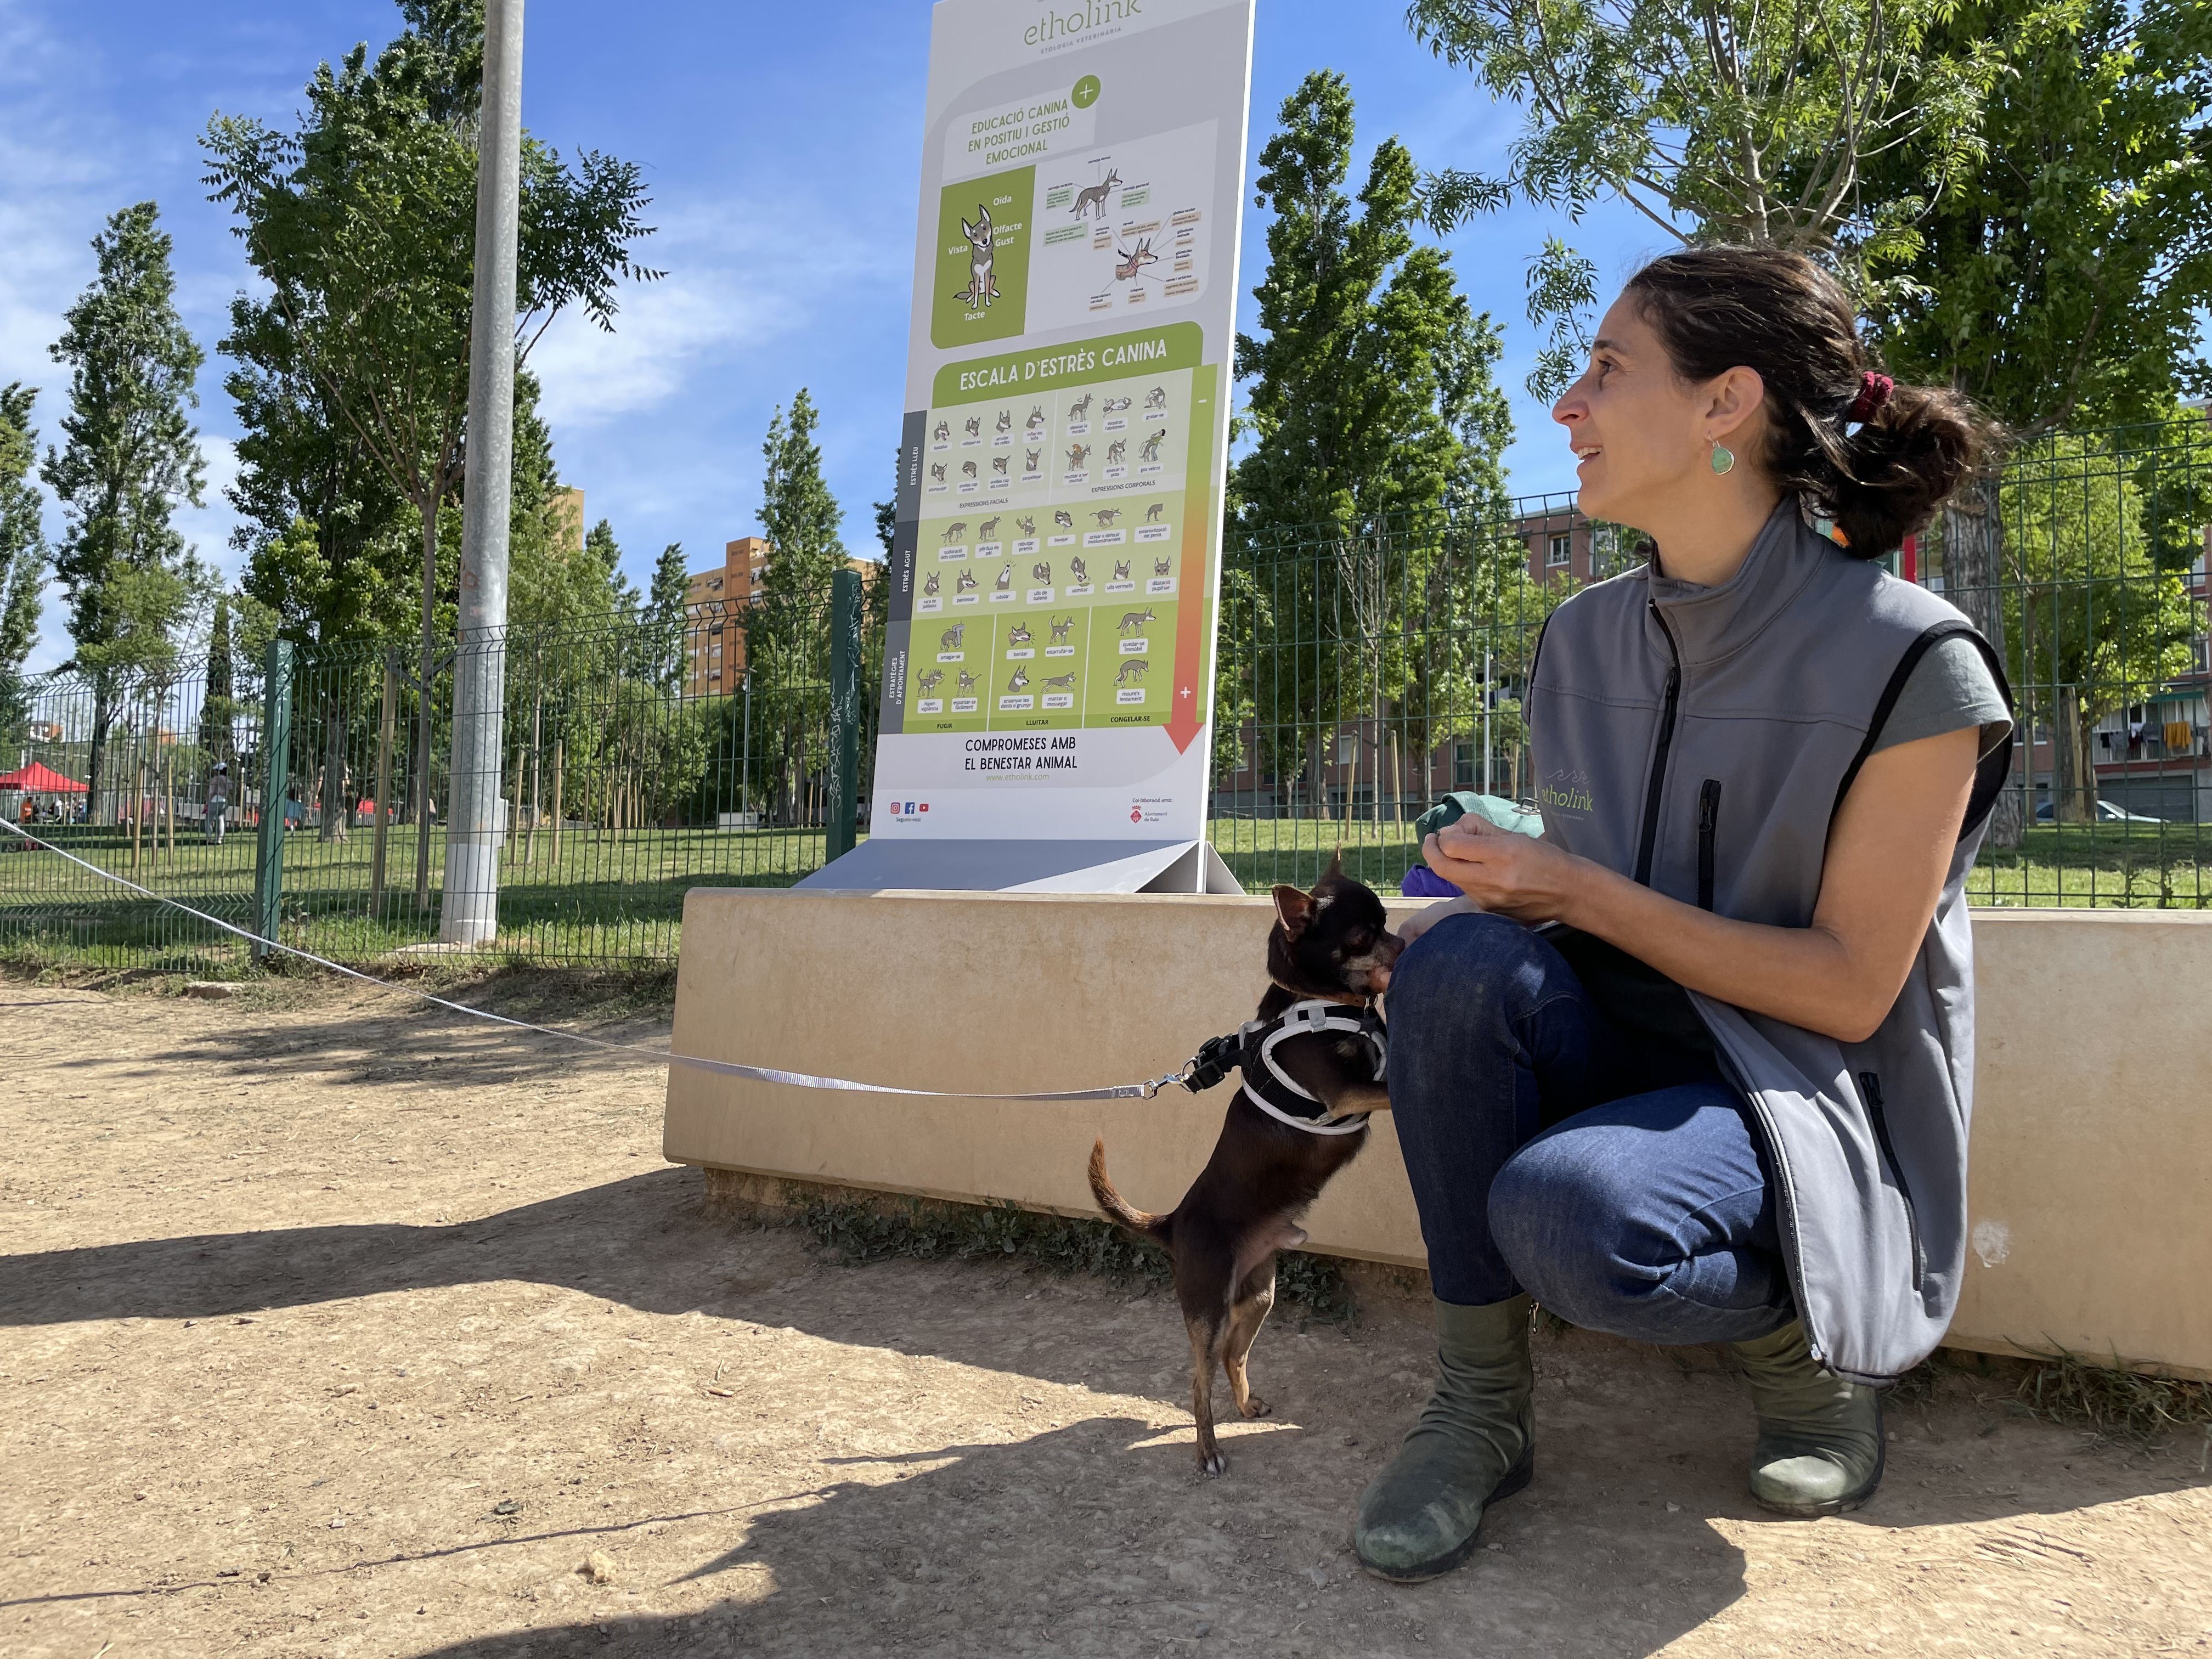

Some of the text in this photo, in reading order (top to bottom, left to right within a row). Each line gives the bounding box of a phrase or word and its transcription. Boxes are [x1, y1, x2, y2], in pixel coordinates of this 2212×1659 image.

[1024, 0, 1142, 45] etholink
[1041, 41, 1074, 54] ETOLOGIA
[972, 99, 1068, 134] EDUCACIÓ CANINA
[968, 112, 1069, 152] EN POSITIU I GESTIÓ
[986, 139, 1048, 165] EMOCIONAL
[993, 223, 1023, 235] Olfacte
[995, 236, 1014, 247] Gust
[948, 245, 968, 255] Vista
[964, 312, 985, 321] Tacte
[960, 338, 1167, 391] ESCALA D'ESTRÈS CANINA
[1091, 480, 1155, 493] EXPRESSIONS CORPORALS
[960, 500, 989, 509] EXPRESSIONS
[889, 657, 898, 698] ESTRATÈGIES
[896, 650, 906, 704] D'AFRONTAMENT
[966, 737, 1076, 751] COMPROMESES AMB
[965, 756, 1077, 770] EL BENESTAR ANIMAL
[986, 772, 1049, 781] www.etholink.com
[1542, 784, 1593, 812] etholink
